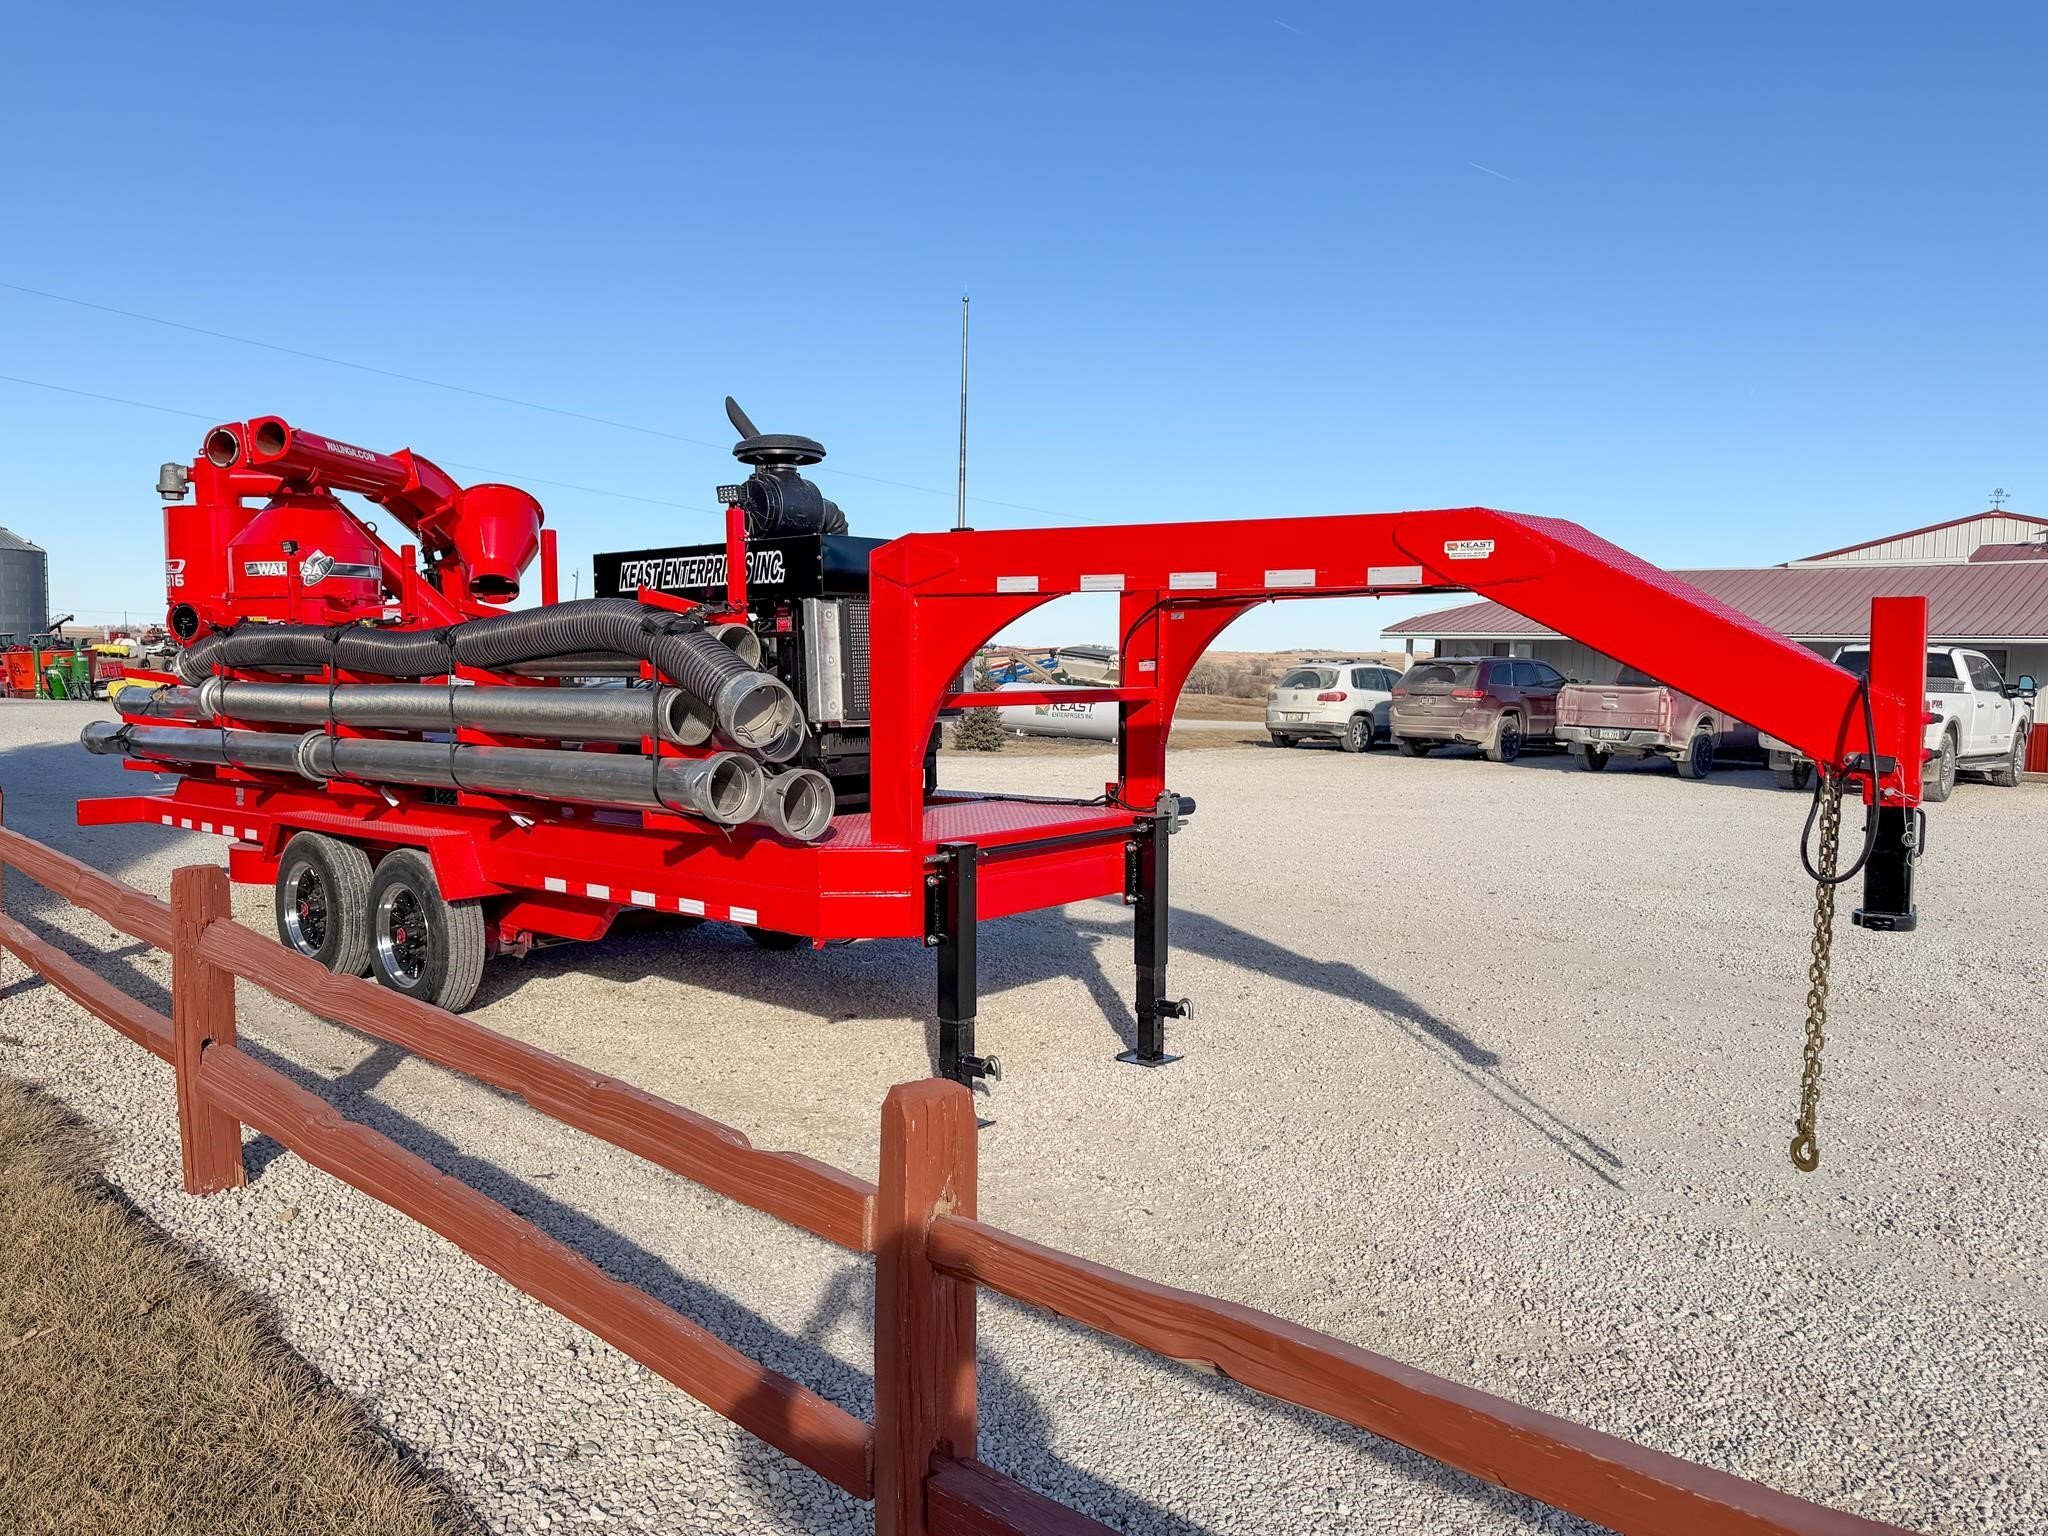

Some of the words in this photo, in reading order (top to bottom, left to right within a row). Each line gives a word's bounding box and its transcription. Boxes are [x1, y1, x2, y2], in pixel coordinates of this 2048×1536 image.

[324, 440, 376, 462] WALINGA.COM
[619, 561, 664, 592] KEAST
[661, 553, 755, 590] ENTERPRIS
[753, 550, 786, 585] INC.
